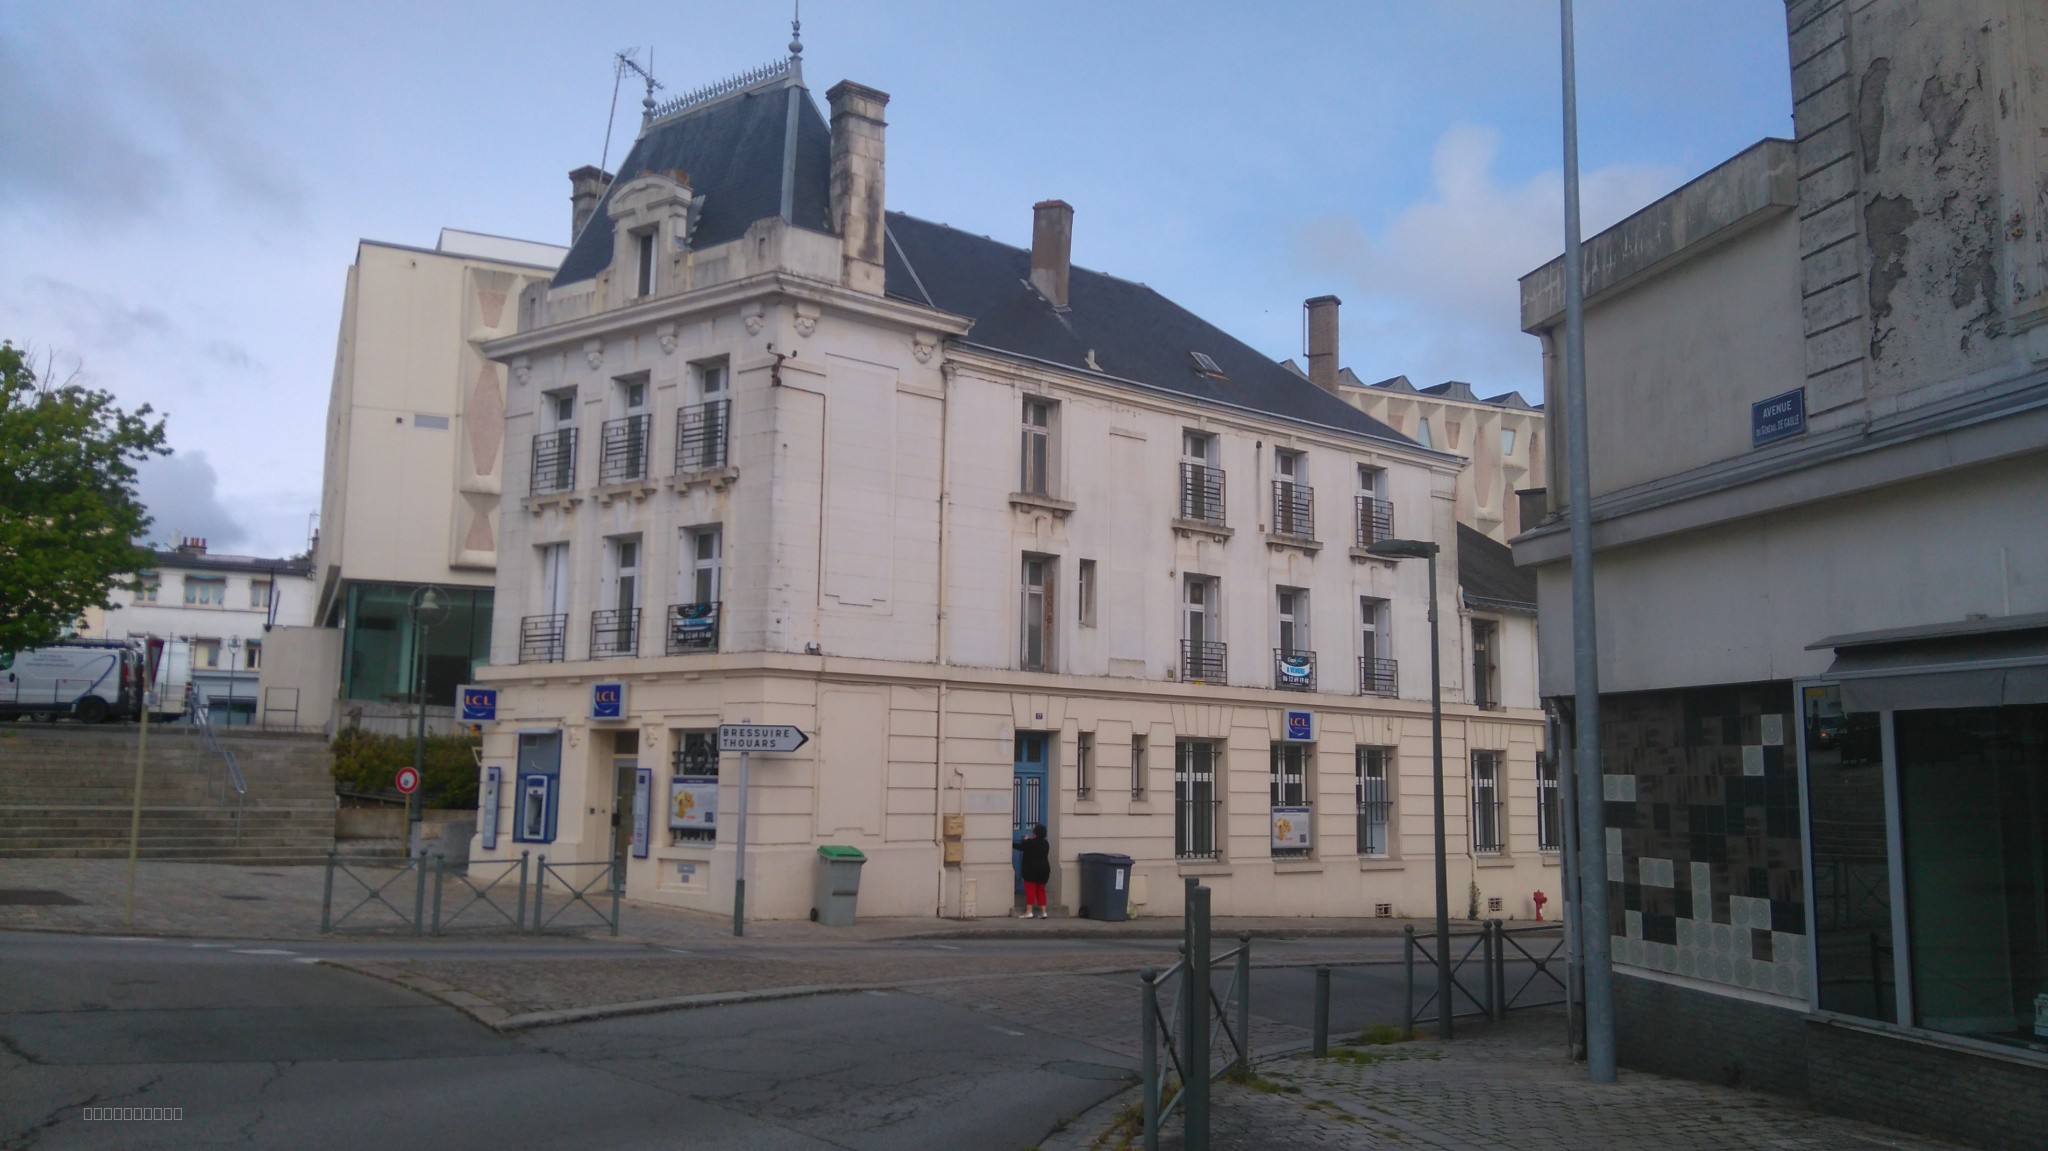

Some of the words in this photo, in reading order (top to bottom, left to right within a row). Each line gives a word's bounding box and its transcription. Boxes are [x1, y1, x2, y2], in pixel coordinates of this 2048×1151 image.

[1763, 400, 1792, 418] AVENUE
[465, 695, 491, 706] LCL
[596, 690, 617, 702] LCL
[1290, 717, 1308, 727] LCL
[723, 728, 790, 739] BRESSUIRE
[723, 739, 777, 749] THOUARS
